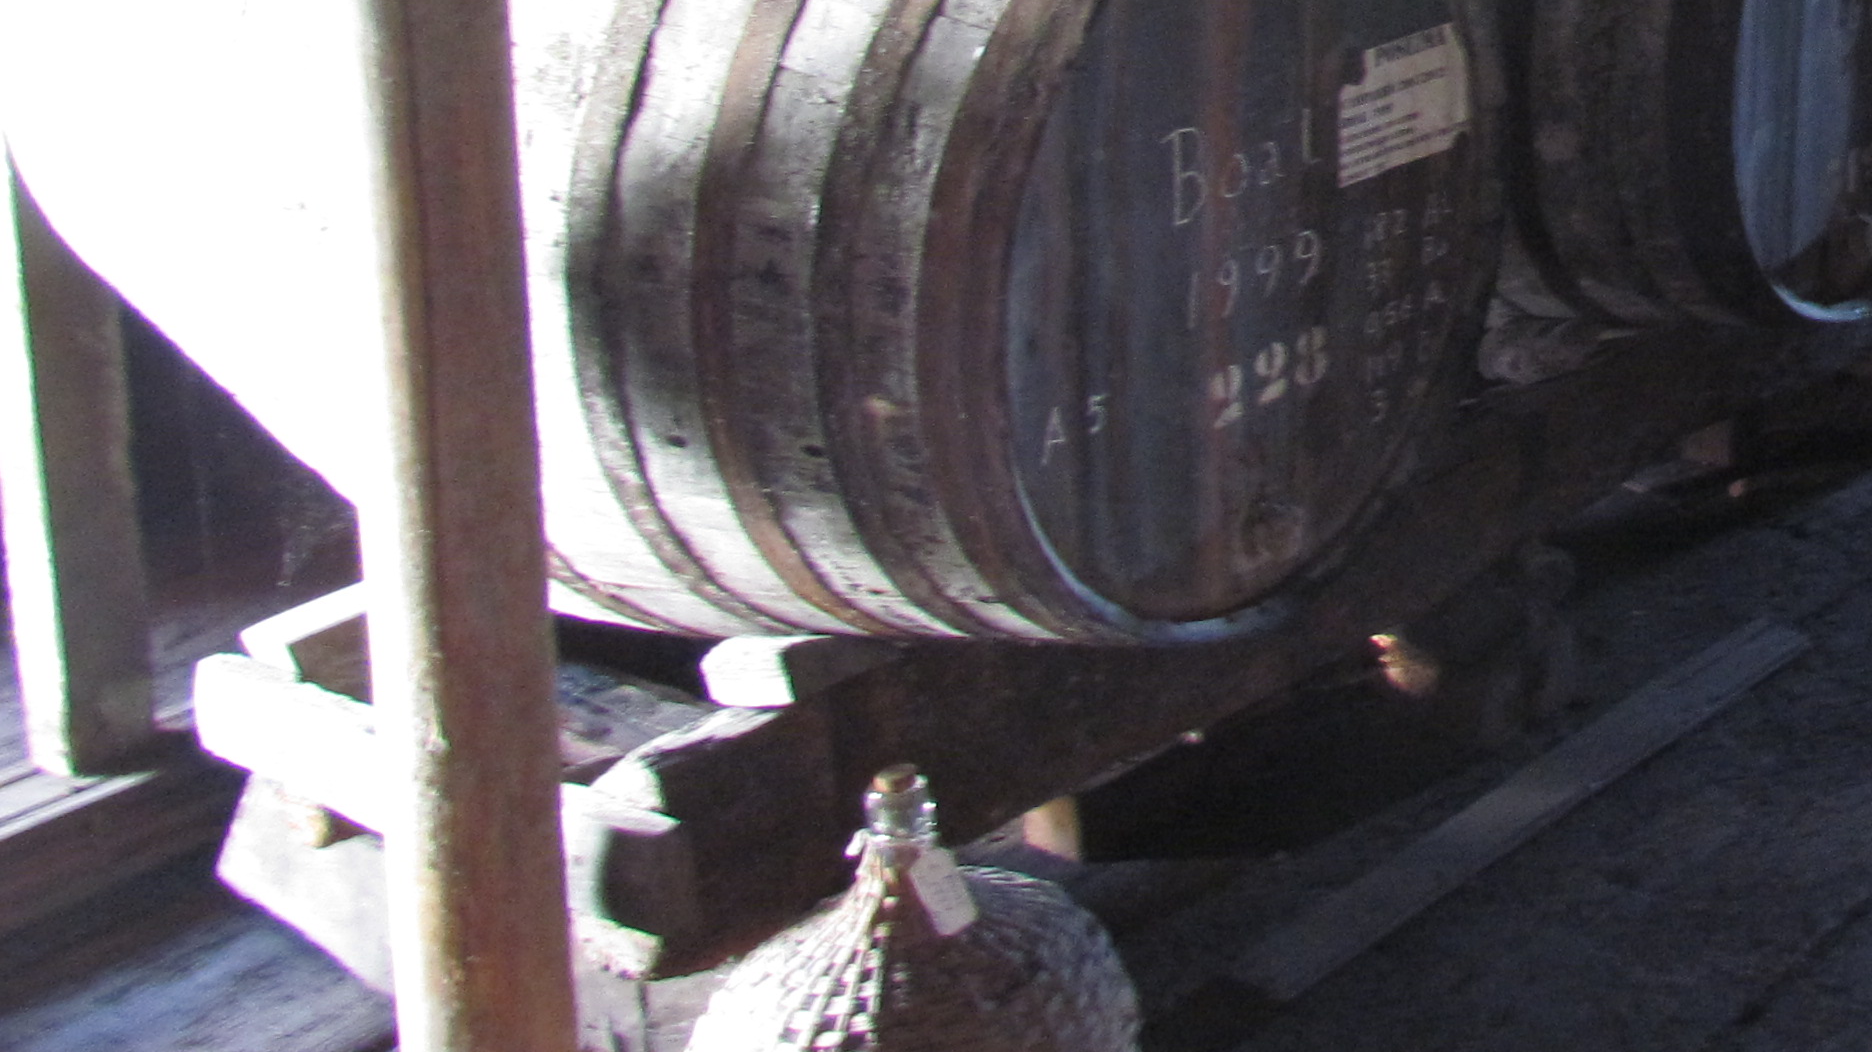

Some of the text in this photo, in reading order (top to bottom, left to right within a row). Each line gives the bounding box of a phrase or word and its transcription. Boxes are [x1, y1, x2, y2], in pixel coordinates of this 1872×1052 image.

[1161, 108, 1322, 226] Boal
[1187, 230, 1322, 330] 1999
[1208, 326, 1328, 430] 228
[1041, 406, 1067, 466] A
